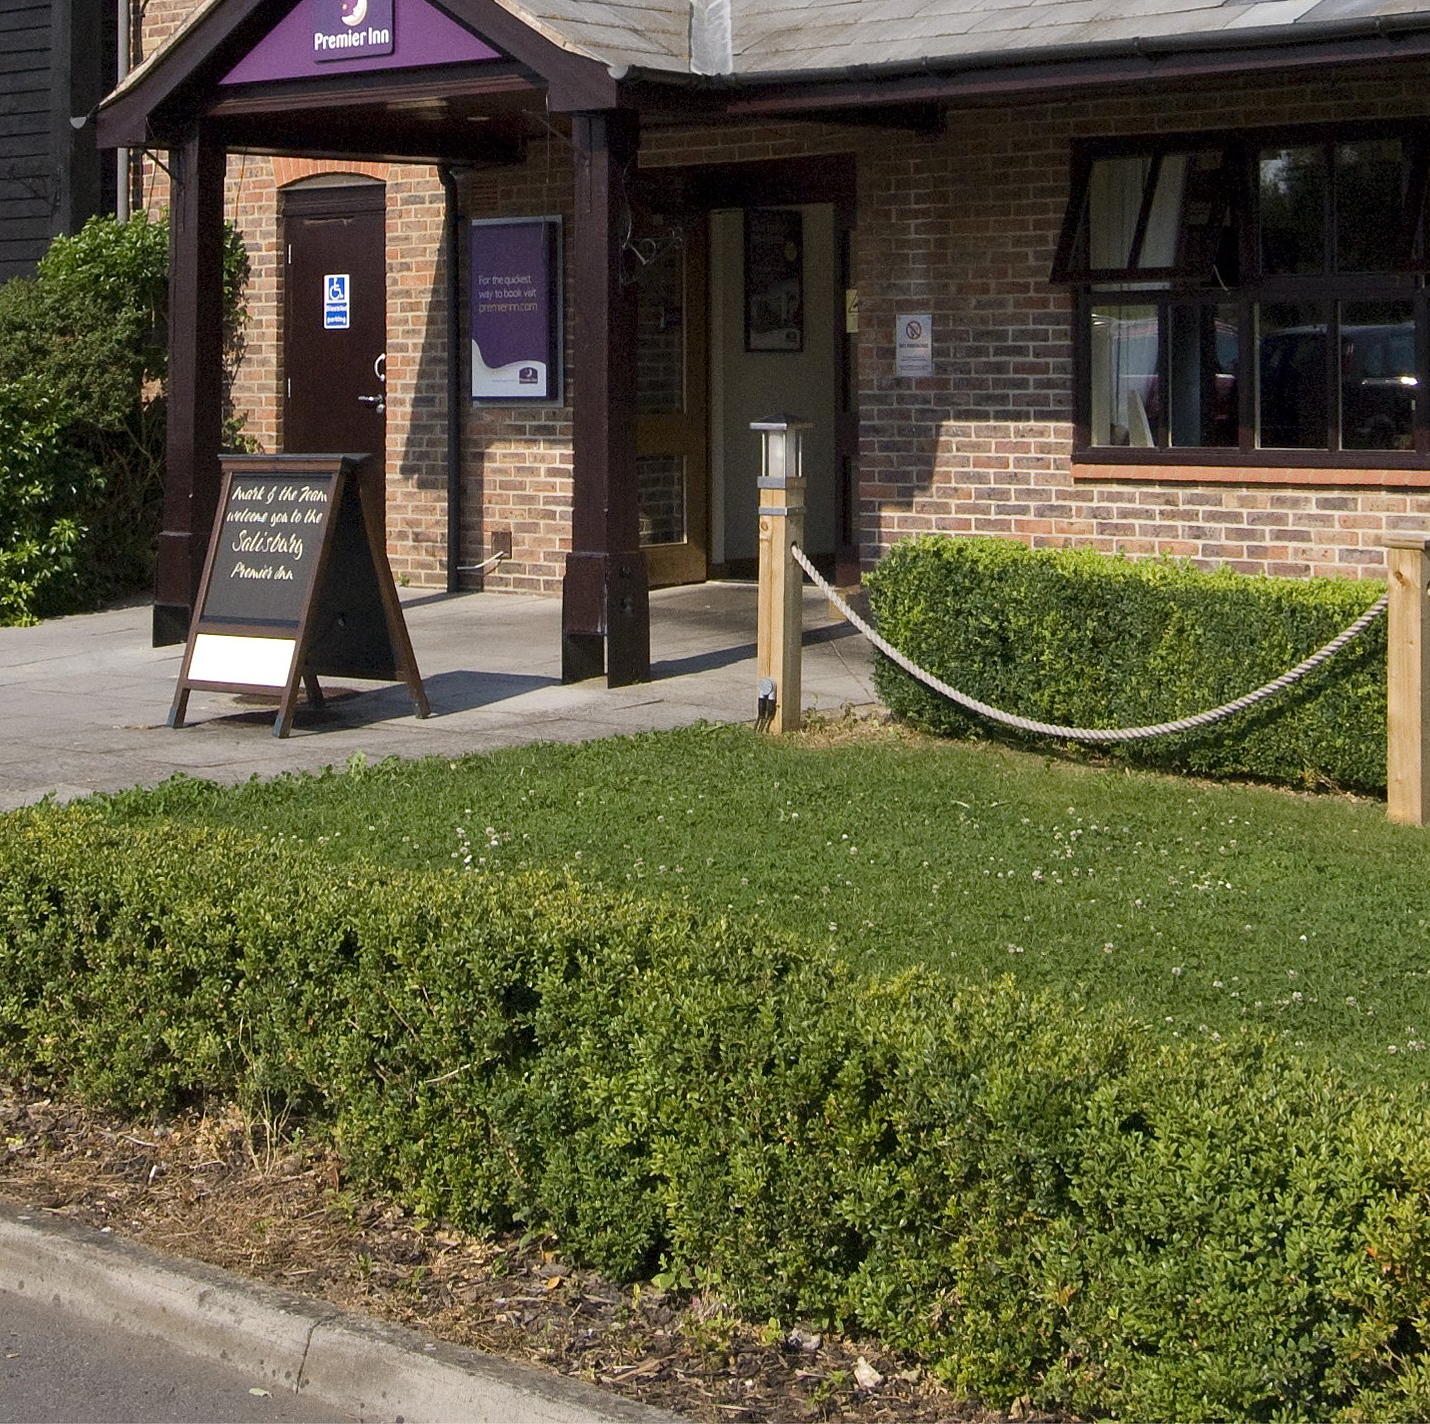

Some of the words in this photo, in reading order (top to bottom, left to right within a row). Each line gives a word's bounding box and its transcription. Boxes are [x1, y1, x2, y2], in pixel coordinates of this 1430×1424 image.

[314, 29, 367, 51] Premier
[368, 27, 389, 45] Inn
[478, 275, 491, 285] For
[492, 275, 503, 285] the
[478, 290, 493, 300] way
[495, 289, 503, 298] to
[503, 288, 522, 298] book
[278, 486, 298, 501] the
[298, 486, 327, 503] Team
[226, 508, 268, 523] welcome
[270, 512, 288, 528] you
[290, 508, 302, 524] to
[303, 508, 323, 524] the
[232, 529, 303, 561] Salisbury
[230, 561, 273, 580] Premier
